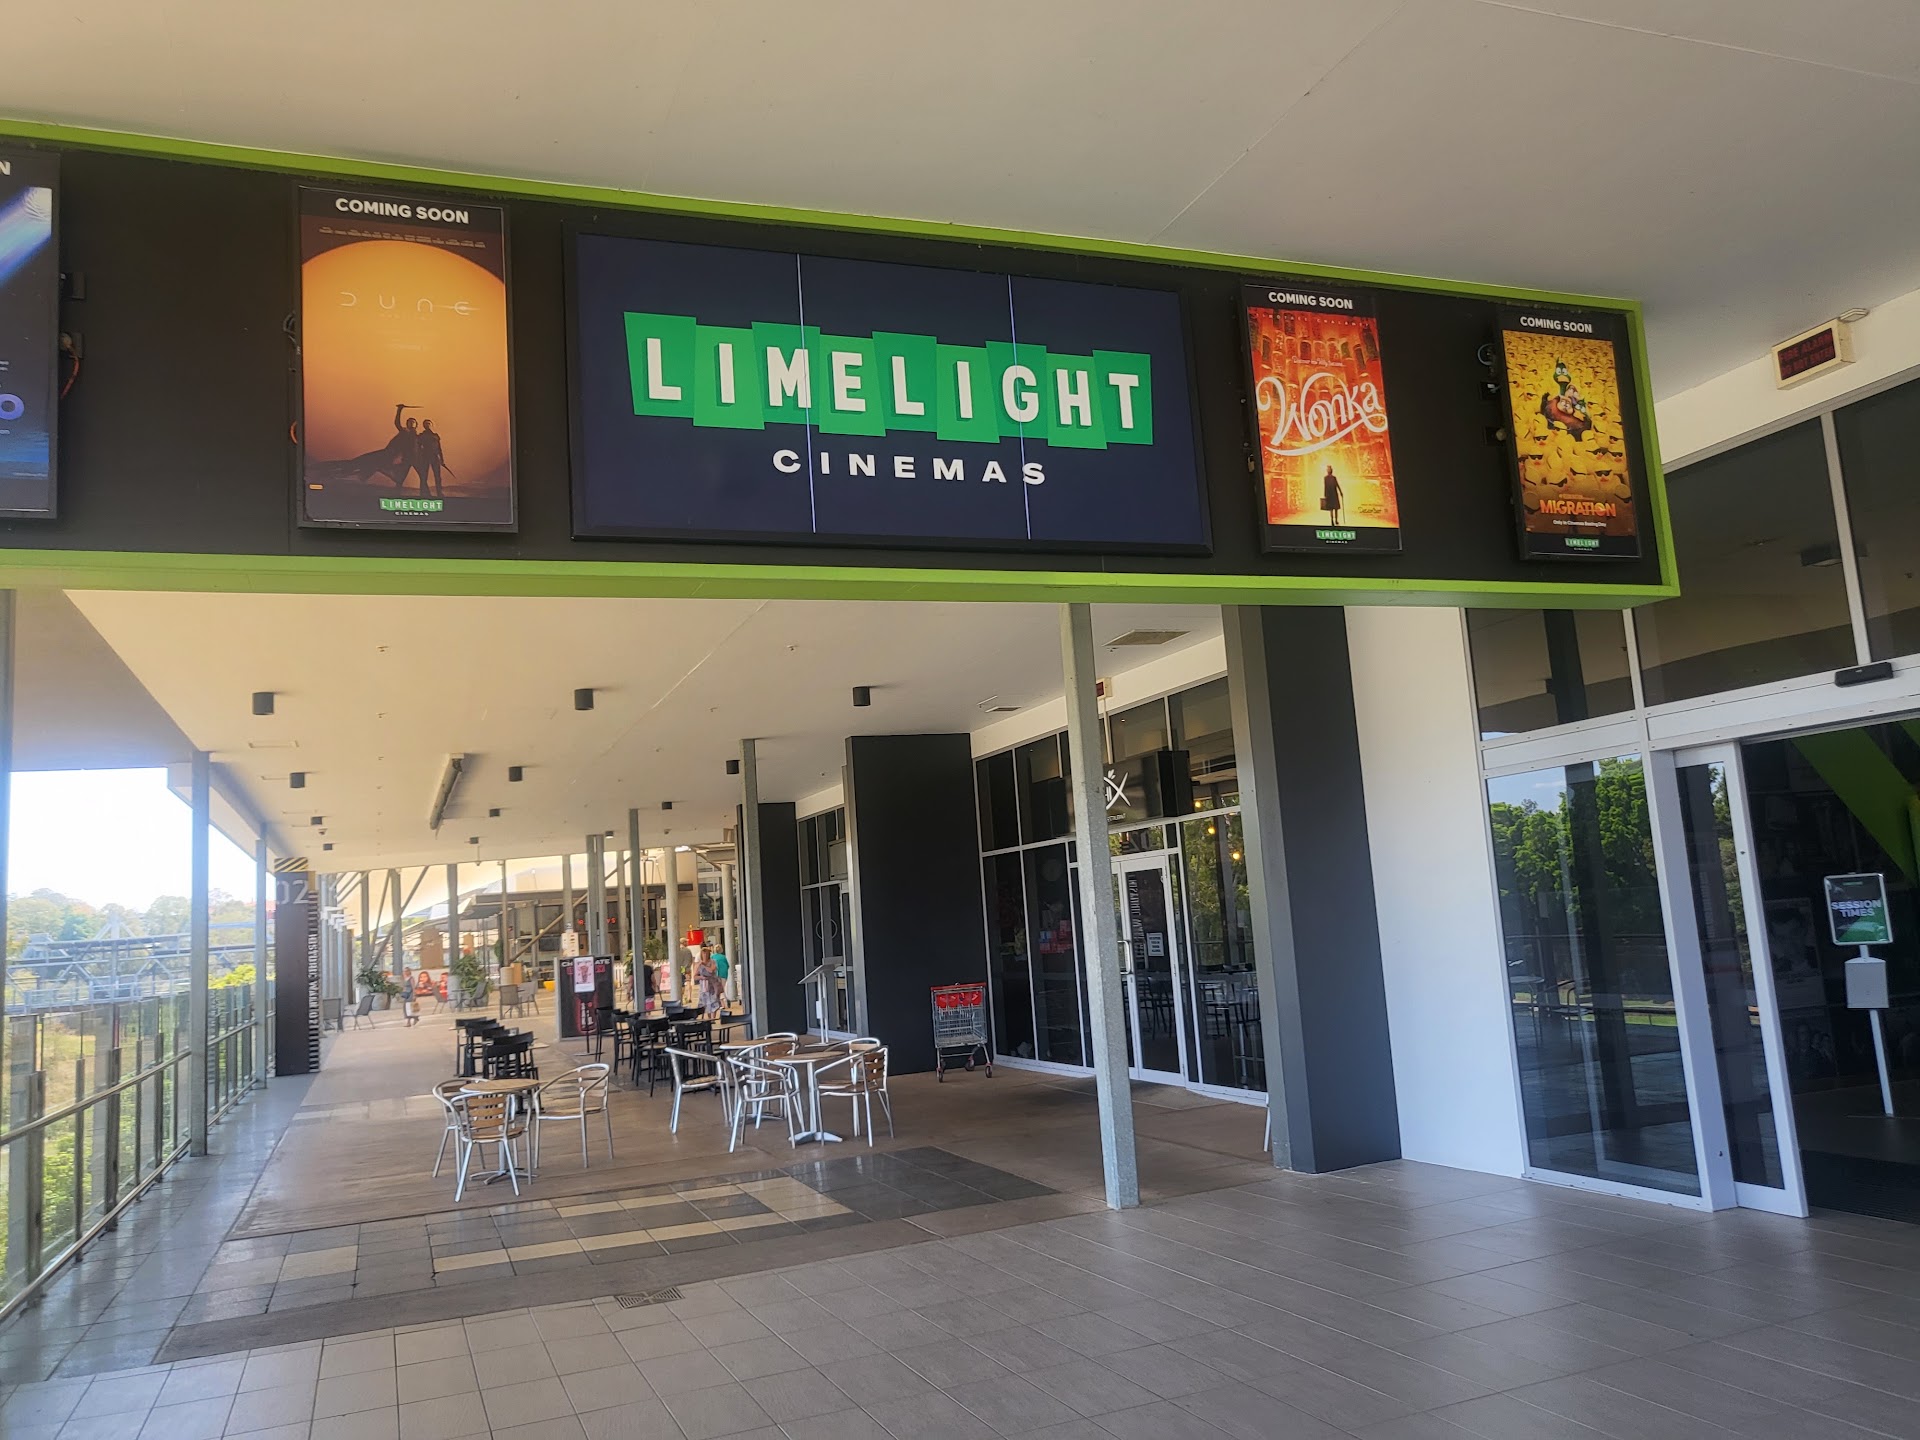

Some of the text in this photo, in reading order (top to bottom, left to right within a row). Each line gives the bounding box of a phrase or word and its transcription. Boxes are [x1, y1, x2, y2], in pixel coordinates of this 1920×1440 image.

[335, 198, 470, 224] COMING SOON
[340, 291, 471, 315] DUNE
[1268, 292, 1353, 309] COMING SOON
[1520, 316, 1593, 333] COMING SOON
[645, 337, 1140, 430] LIMELIGHT
[1256, 372, 1388, 456] Wonka
[772, 449, 1047, 486] CINEMAS
[380, 500, 442, 510] LIMELIGHT
[1540, 499, 1617, 517] MIGRATION
[1316, 531, 1356, 540] LIMELIGHT
[1565, 538, 1599, 547] LIMELIGHT
[1831, 900, 1881, 910] SESSION
[1840, 908, 1875, 917] TIMES
